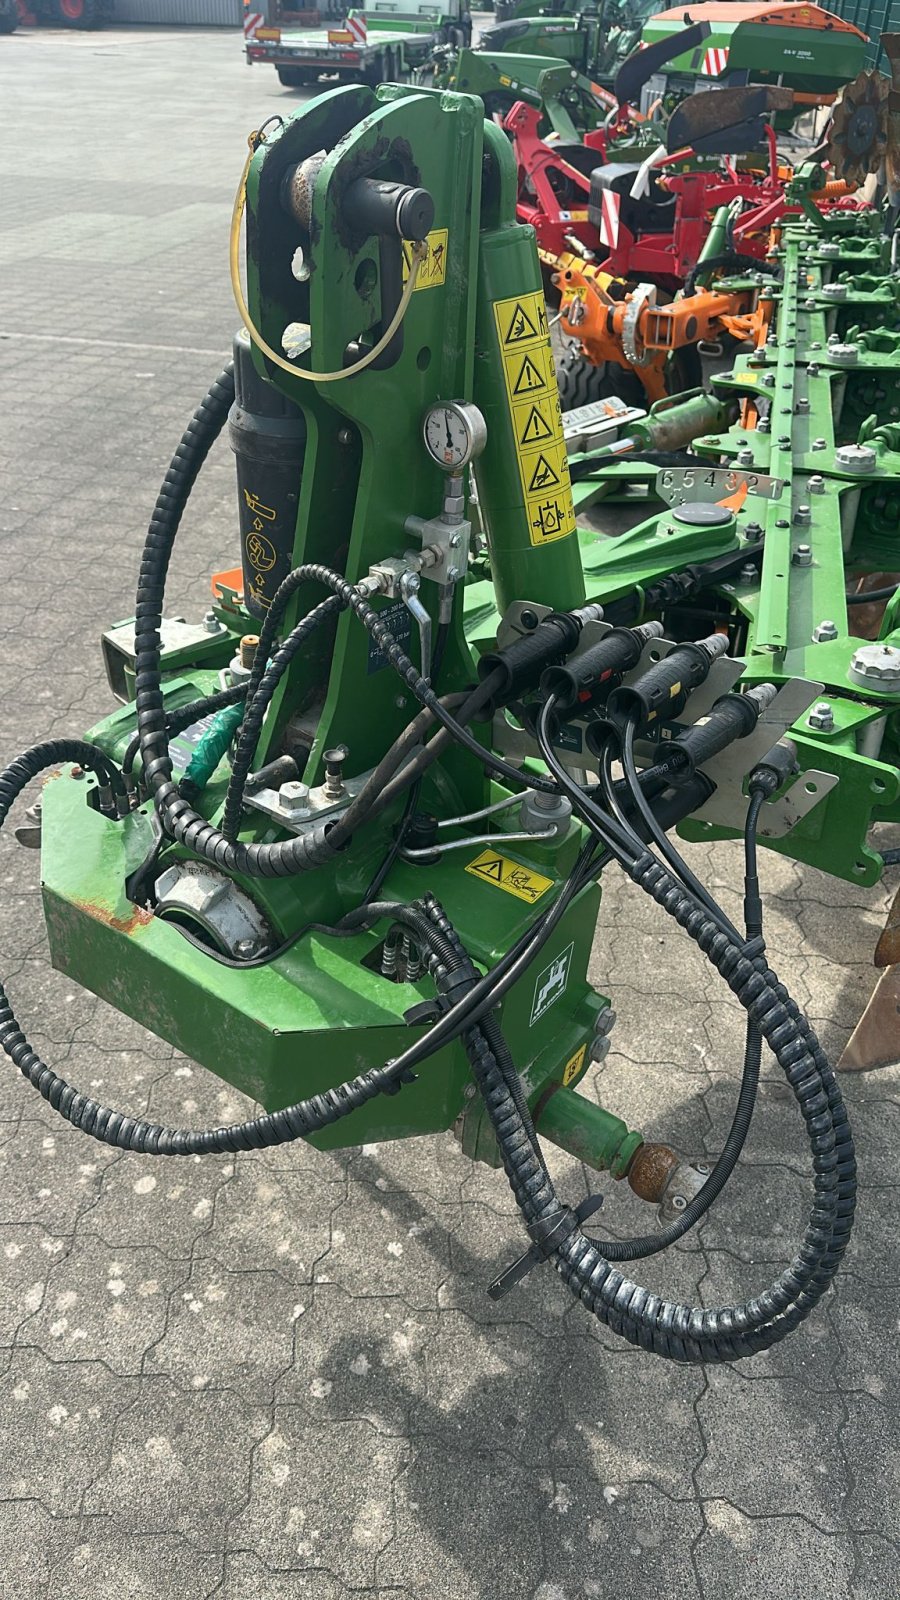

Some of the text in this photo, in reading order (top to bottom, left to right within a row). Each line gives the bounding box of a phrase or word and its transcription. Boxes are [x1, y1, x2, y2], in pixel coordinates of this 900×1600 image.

[662, 470, 778, 498] 6 5 4 3 2 1
